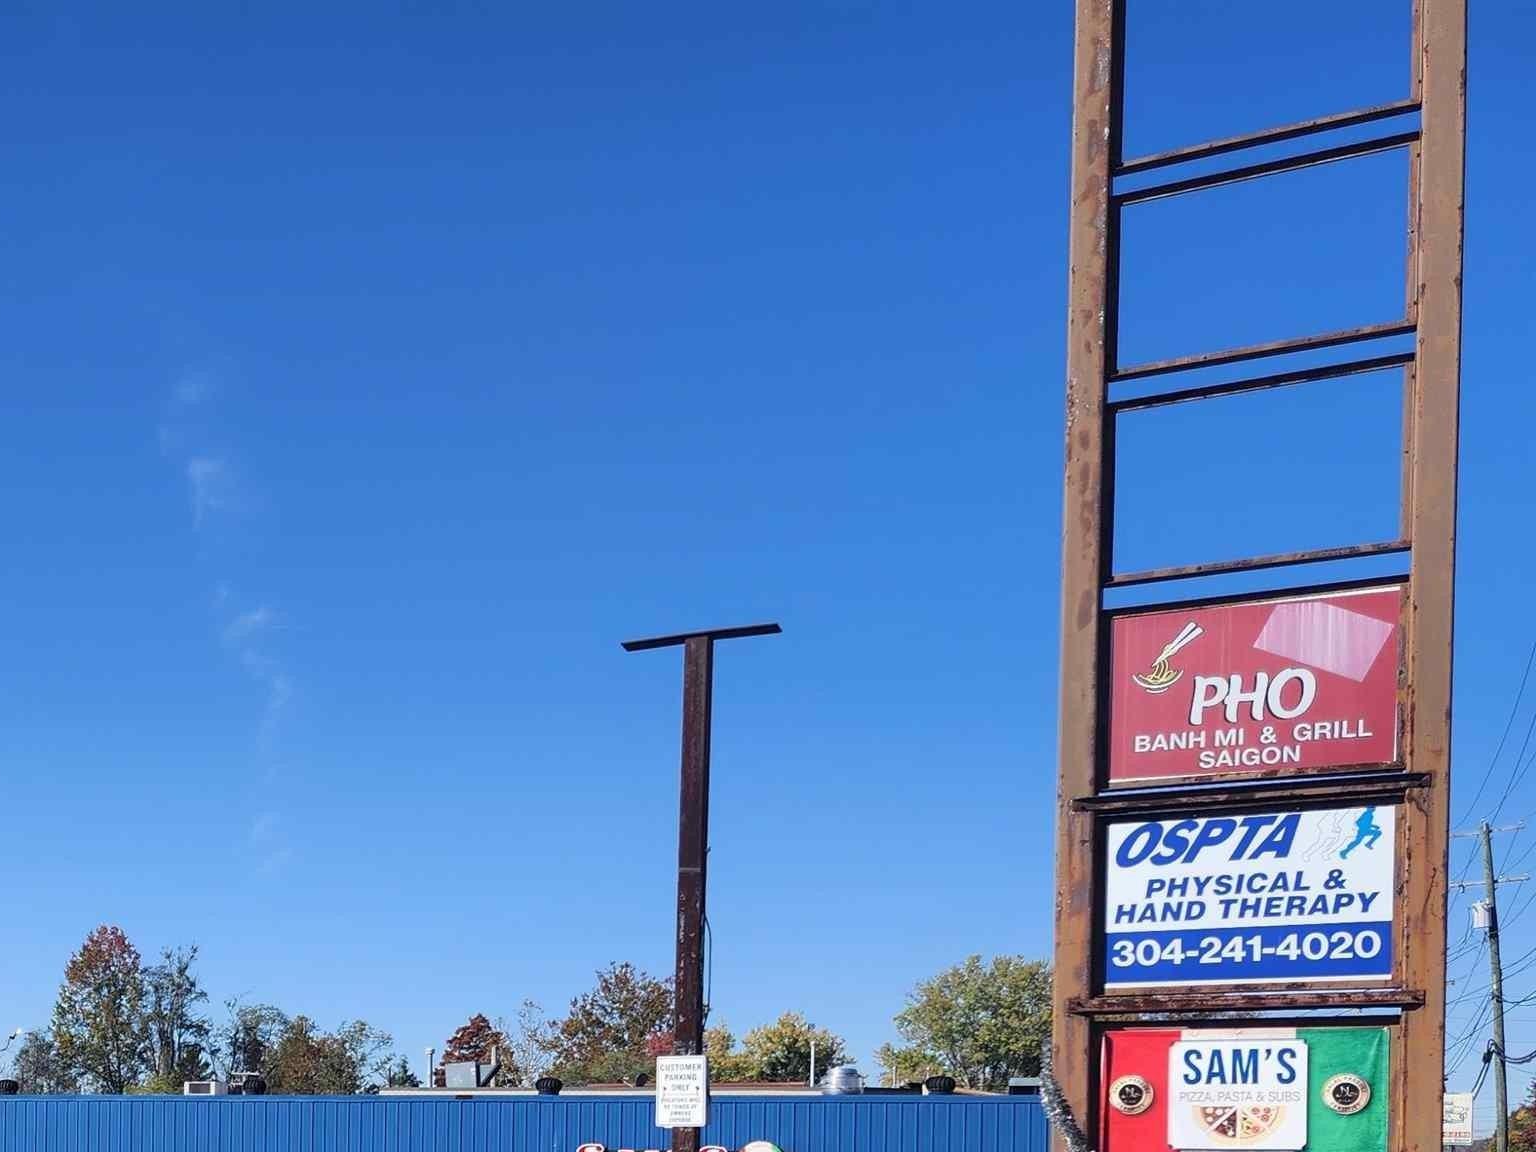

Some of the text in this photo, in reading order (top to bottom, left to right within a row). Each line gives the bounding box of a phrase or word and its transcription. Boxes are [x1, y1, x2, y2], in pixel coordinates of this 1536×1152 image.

[1189, 667, 1316, 725] PHO
[1134, 720, 1373, 752] BANH MI & GRILL
[1199, 745, 1301, 769] SAIGON
[1115, 813, 1301, 868] OSPTA
[1145, 869, 1347, 899] PHYSICAL &
[1114, 891, 1379, 924] HAND THERAPY
[1112, 930, 1382, 968] 304-241-4020
[659, 1063, 701, 1072] CUSTOMER
[664, 1073, 697, 1081] PARKING
[1183, 1047, 1297, 1085] SAM'S
[1217, 1091, 1253, 1103] PASTA
[1256, 1091, 1265, 1103] &
[1268, 1091, 1301, 1103] SUBS
